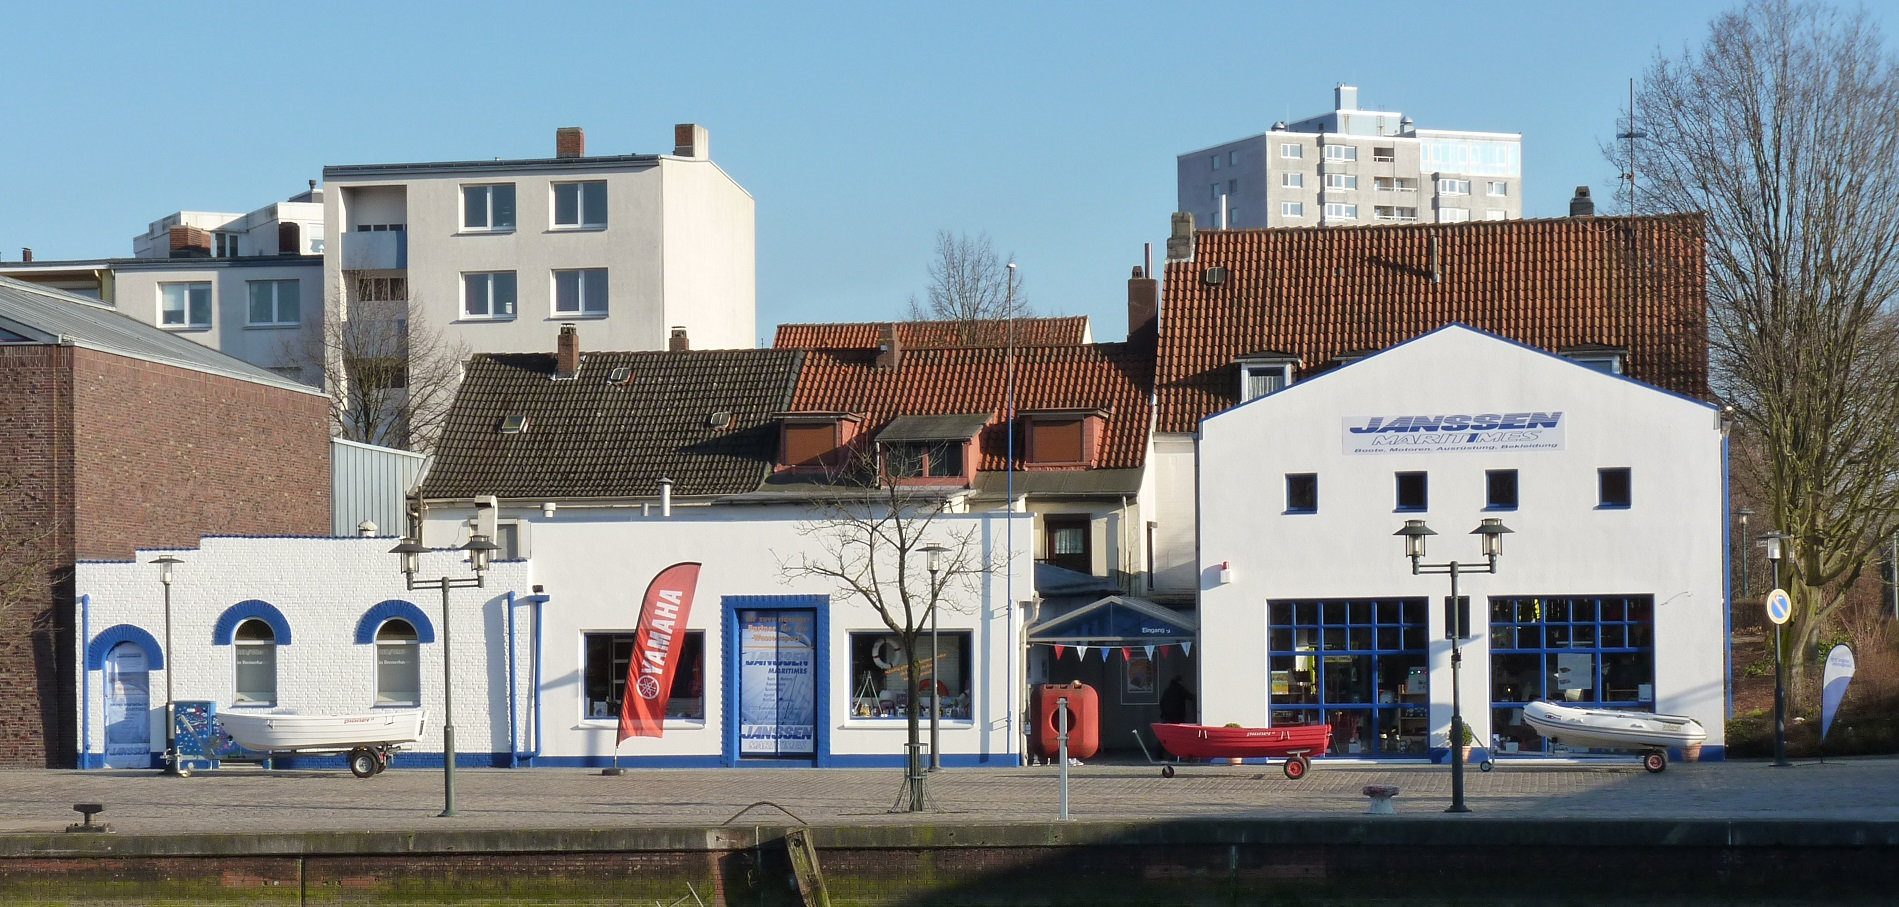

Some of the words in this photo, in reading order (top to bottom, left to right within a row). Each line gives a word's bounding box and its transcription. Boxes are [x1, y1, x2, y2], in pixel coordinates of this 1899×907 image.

[1349, 411, 1562, 434] JANSSEN
[1371, 430, 1542, 446] MARITIMES
[641, 589, 683, 675] YAMAHA
[741, 726, 814, 739] JANSSEN
